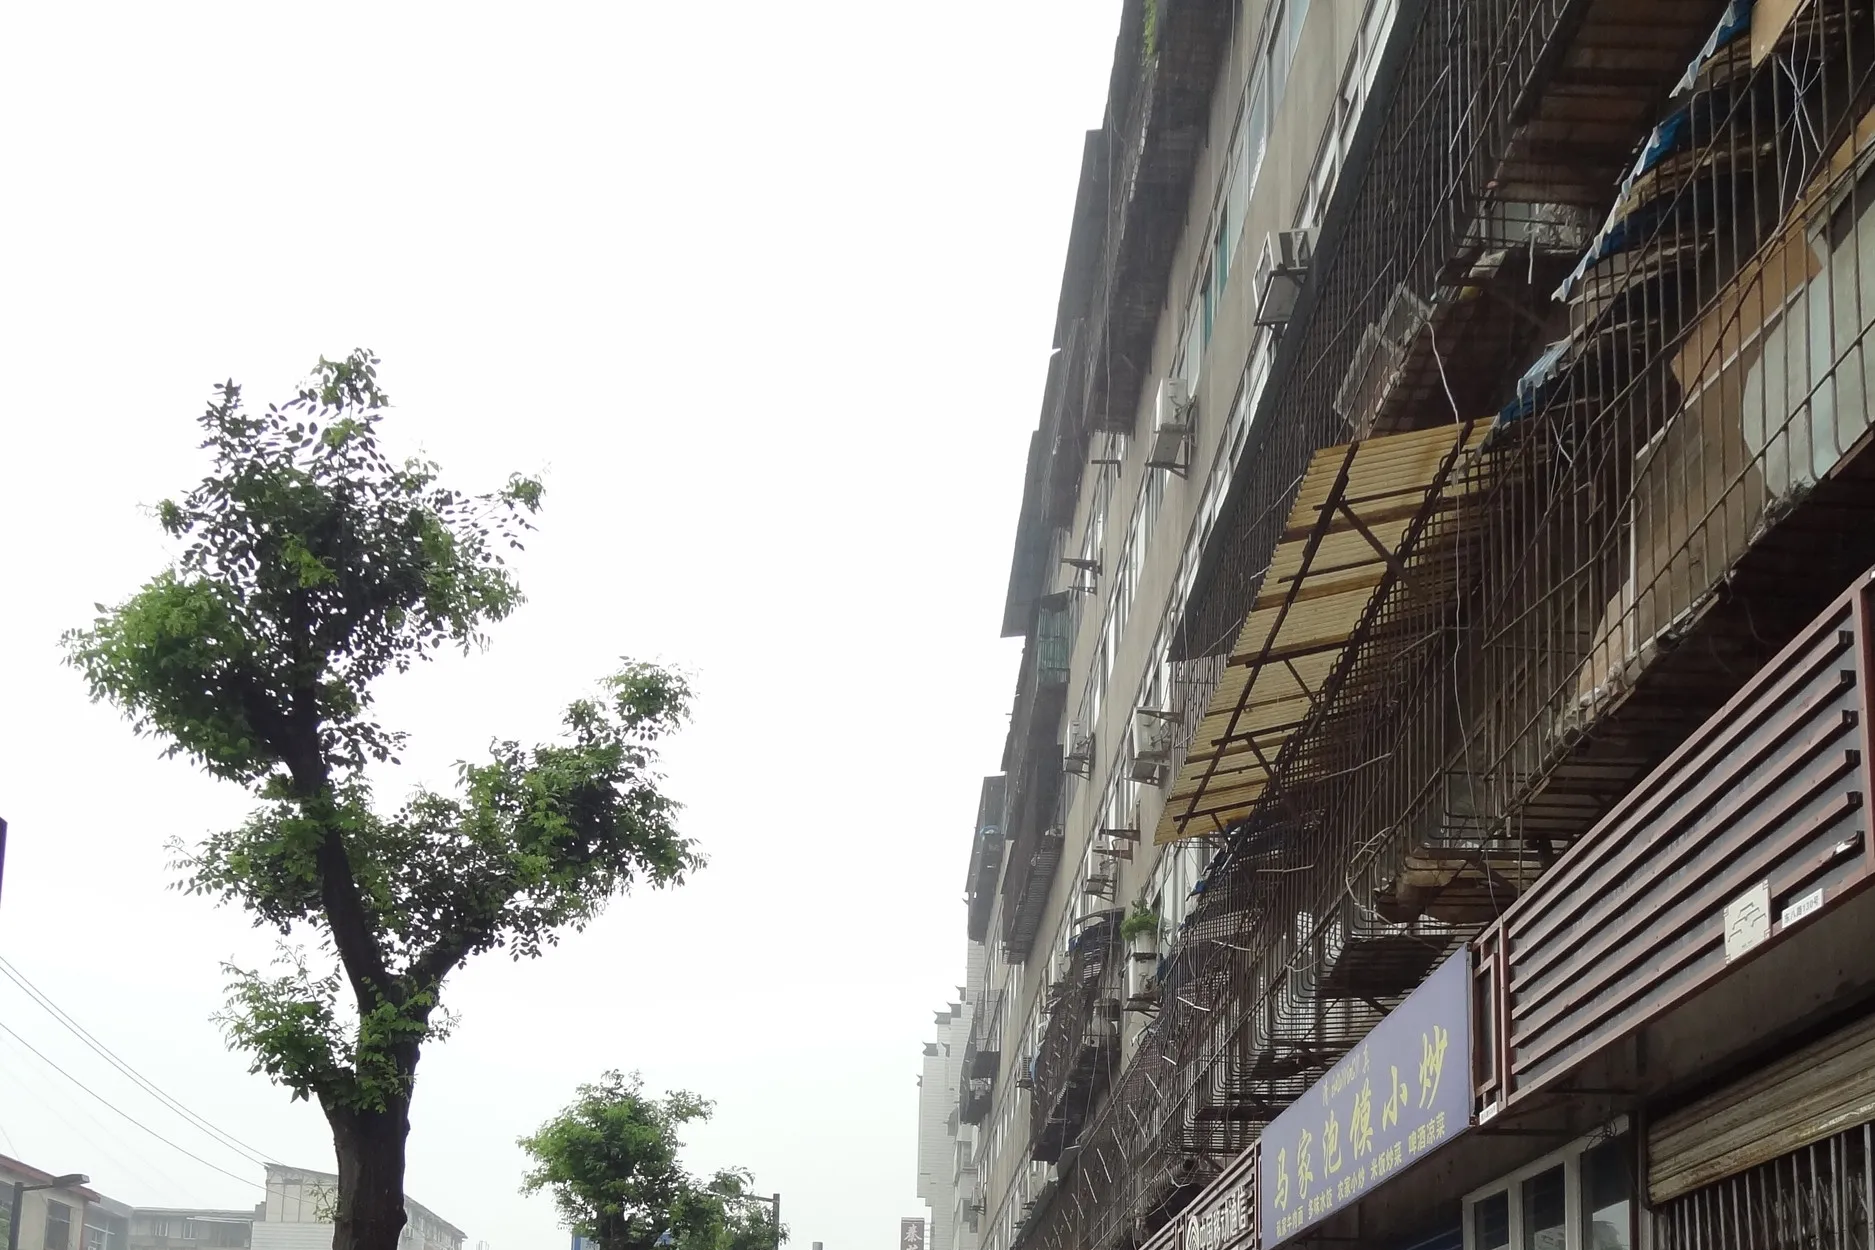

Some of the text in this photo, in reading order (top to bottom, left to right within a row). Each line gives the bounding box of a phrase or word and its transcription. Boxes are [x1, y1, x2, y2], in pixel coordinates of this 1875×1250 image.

[1274, 1026, 1448, 1211] 马家泡馍小炒
[1370, 1141, 1402, 1181] 米饭炒菜
[1408, 1111, 1446, 1155] 啤酒凉菜
